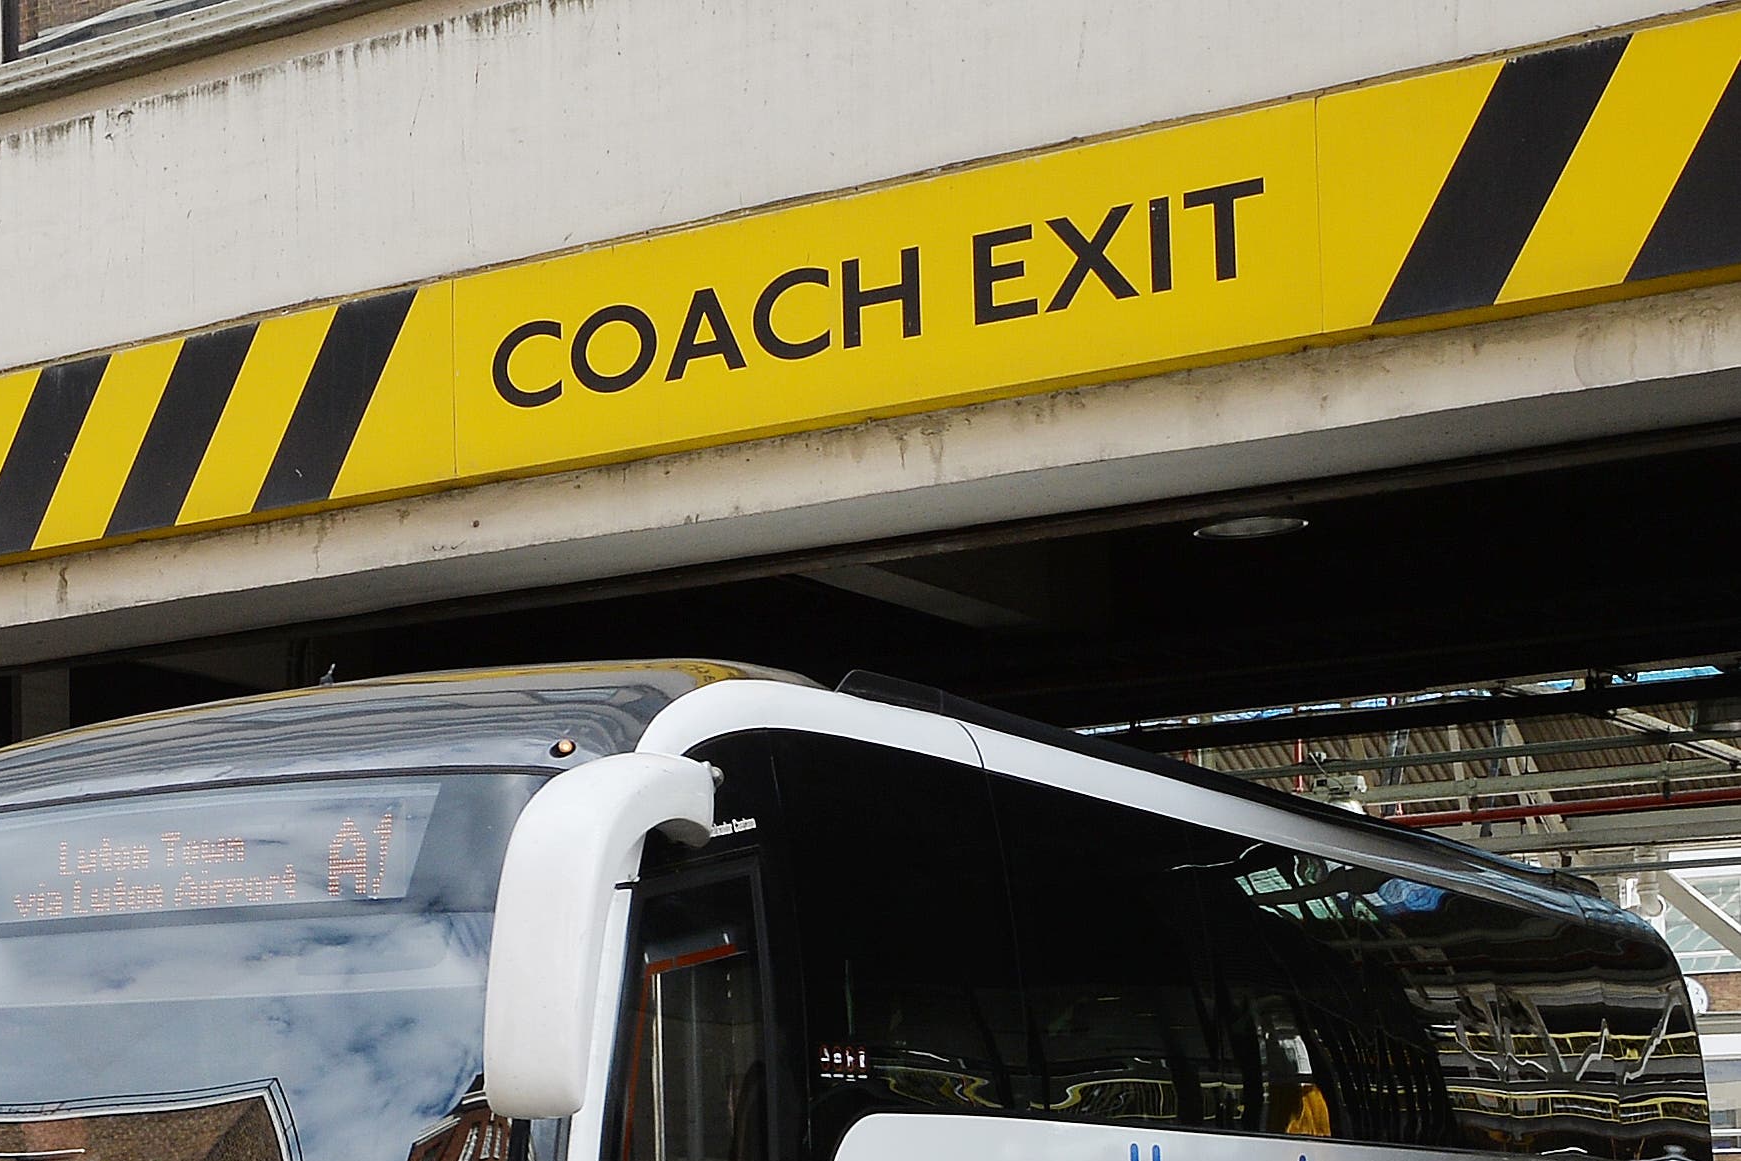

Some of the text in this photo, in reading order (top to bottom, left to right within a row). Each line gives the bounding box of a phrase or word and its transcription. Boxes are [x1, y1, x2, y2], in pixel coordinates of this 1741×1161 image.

[491, 176, 1265, 409] COACH EXIT
[59, 830, 245, 876] Luton Town
[327, 811, 394, 897] A1
[13, 863, 297, 918] via Luton Airport
